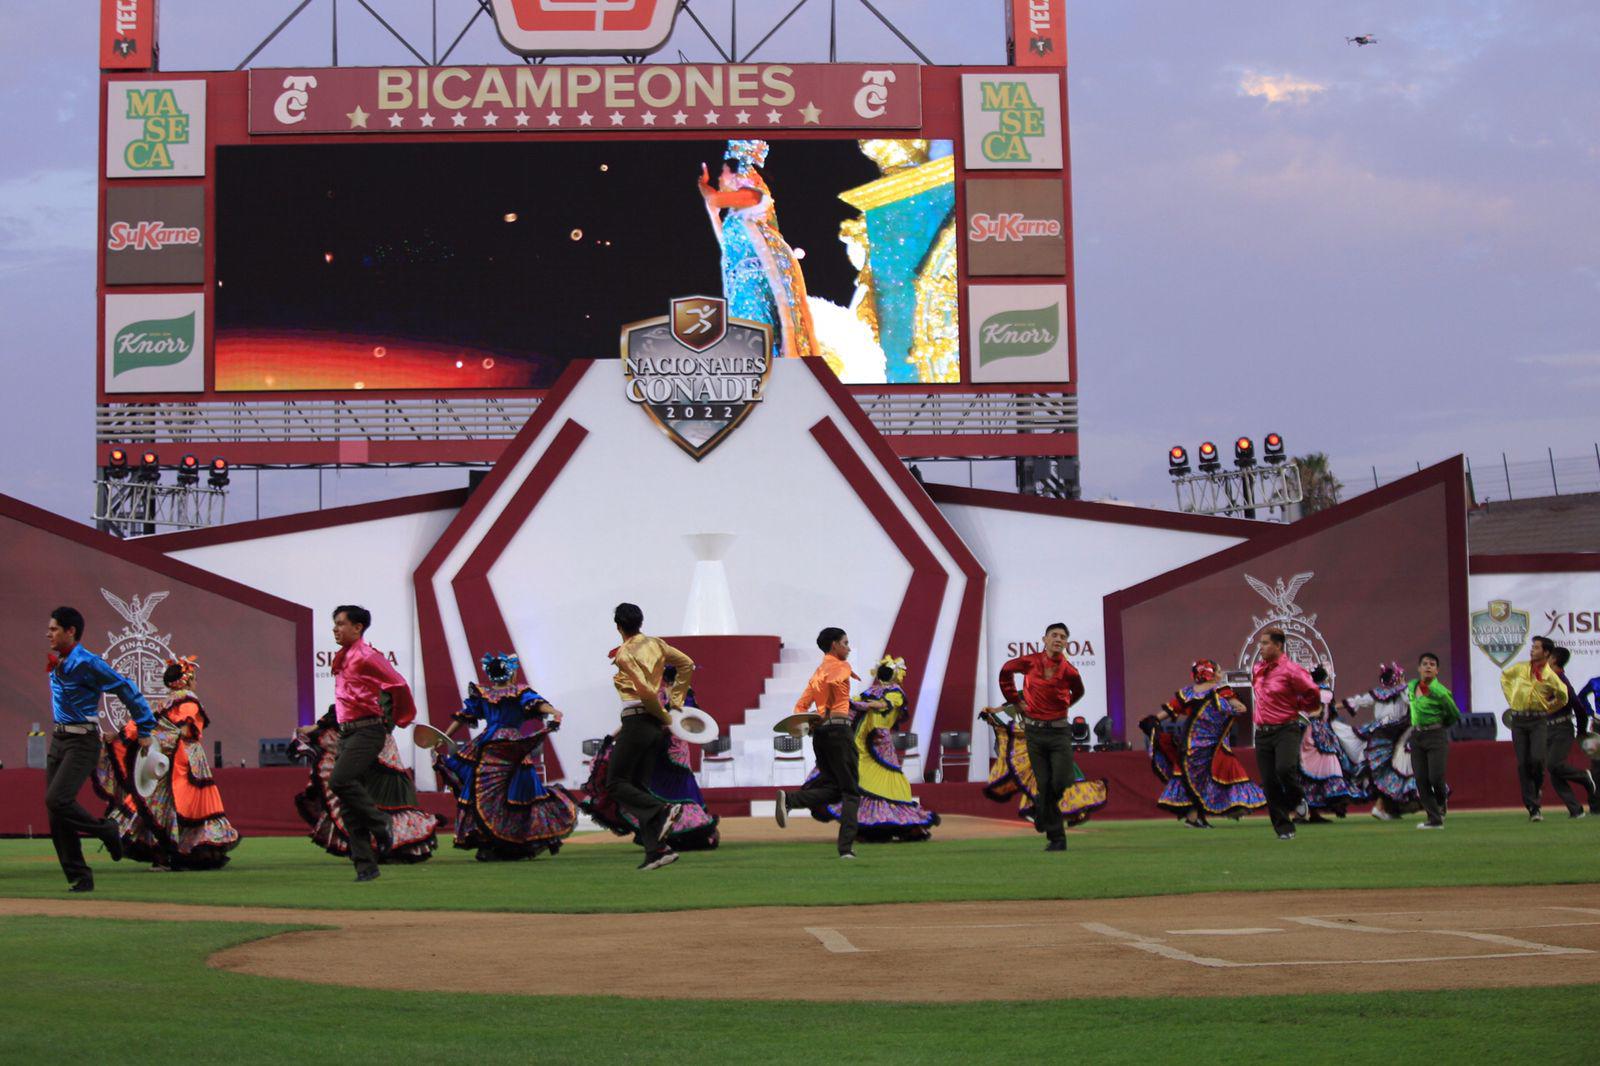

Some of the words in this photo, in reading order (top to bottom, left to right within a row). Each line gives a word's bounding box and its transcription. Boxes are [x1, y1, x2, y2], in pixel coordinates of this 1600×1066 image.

[378, 65, 796, 109] BICAMPEONES
[108, 222, 200, 250] SuKarne
[970, 214, 1060, 241] SuKarne
[117, 332, 189, 353] Knorr
[983, 323, 1054, 344] Knorr
[624, 357, 767, 375] NACIONALES
[626, 376, 764, 403] CONADE
[666, 407, 733, 418] 2022
[119, 641, 161, 653] SINALOA
